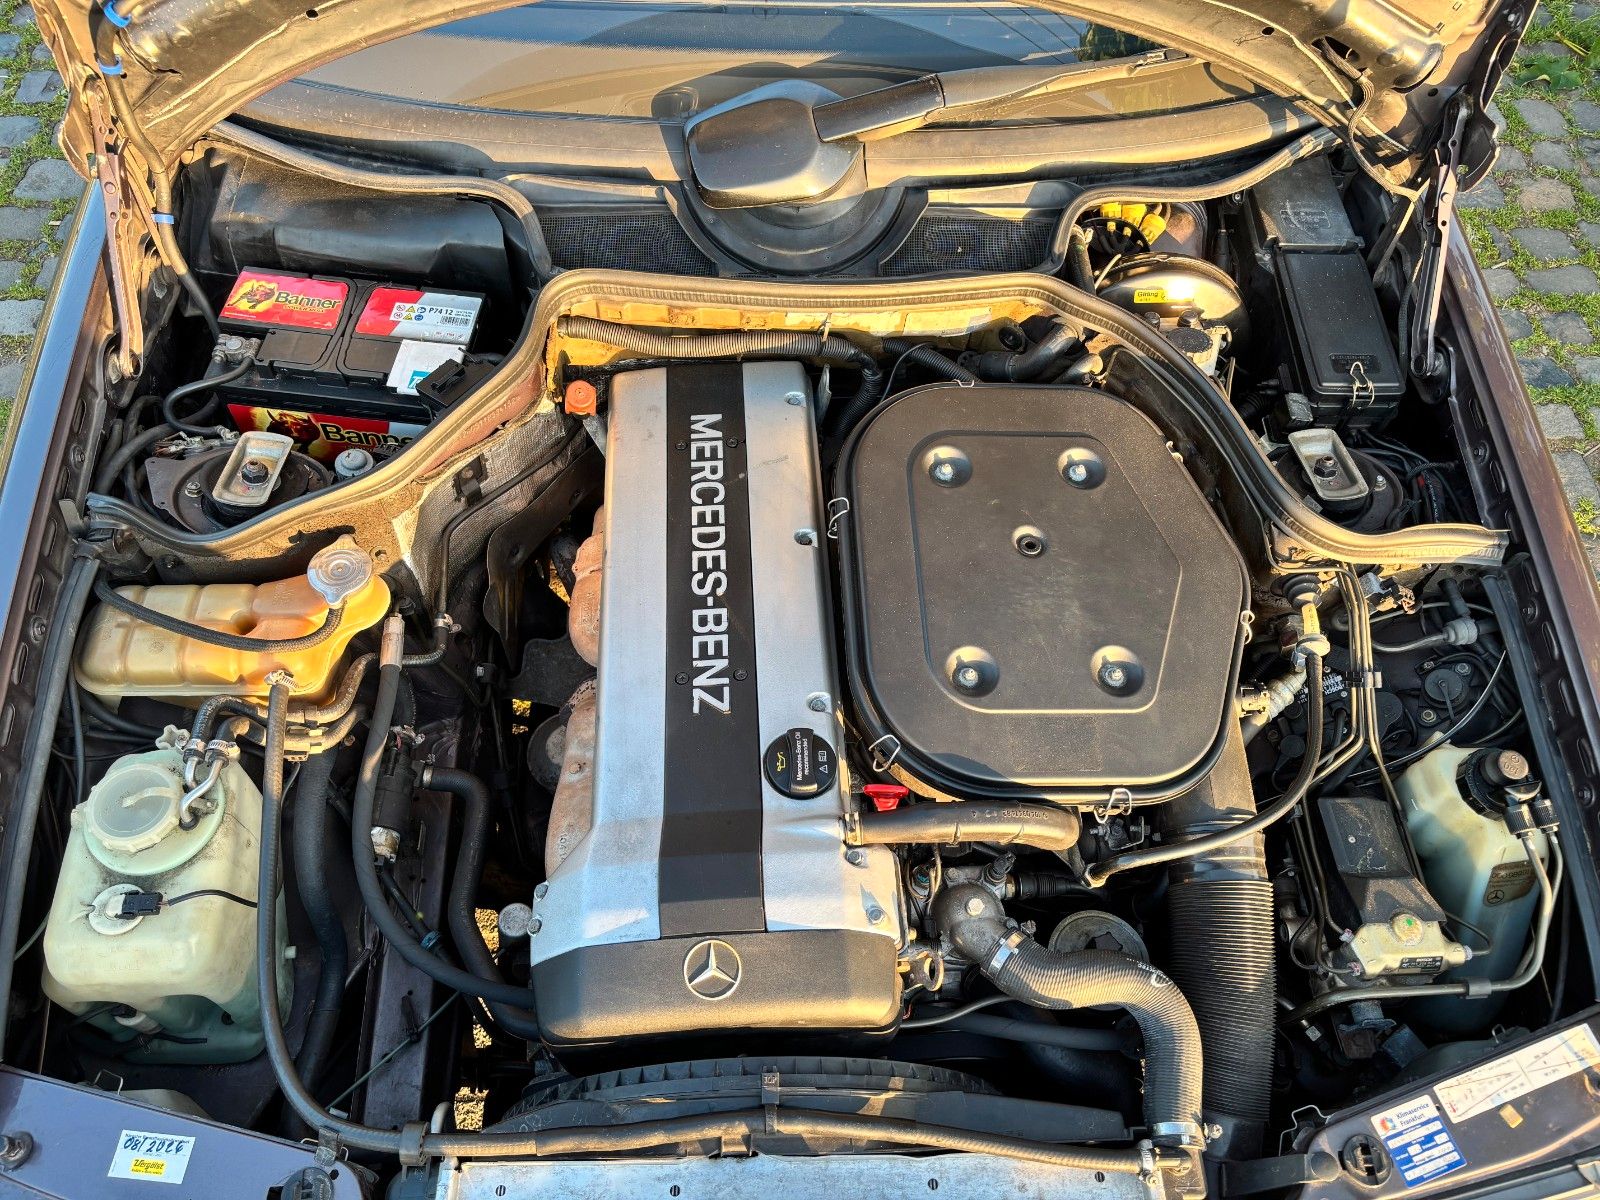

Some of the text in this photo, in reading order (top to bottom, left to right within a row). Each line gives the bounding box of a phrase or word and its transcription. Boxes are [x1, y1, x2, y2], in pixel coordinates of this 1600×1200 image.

[275, 292, 341, 309] Banner
[690, 413, 732, 715] MERCEDES-BENZ
[795, 739, 803, 781] Mercedes-Benz
[1396, 1102, 1430, 1120] Klimaservice
[1400, 1113, 1425, 1127] Frankfurt
[133, 1159, 165, 1170] Vergölst
